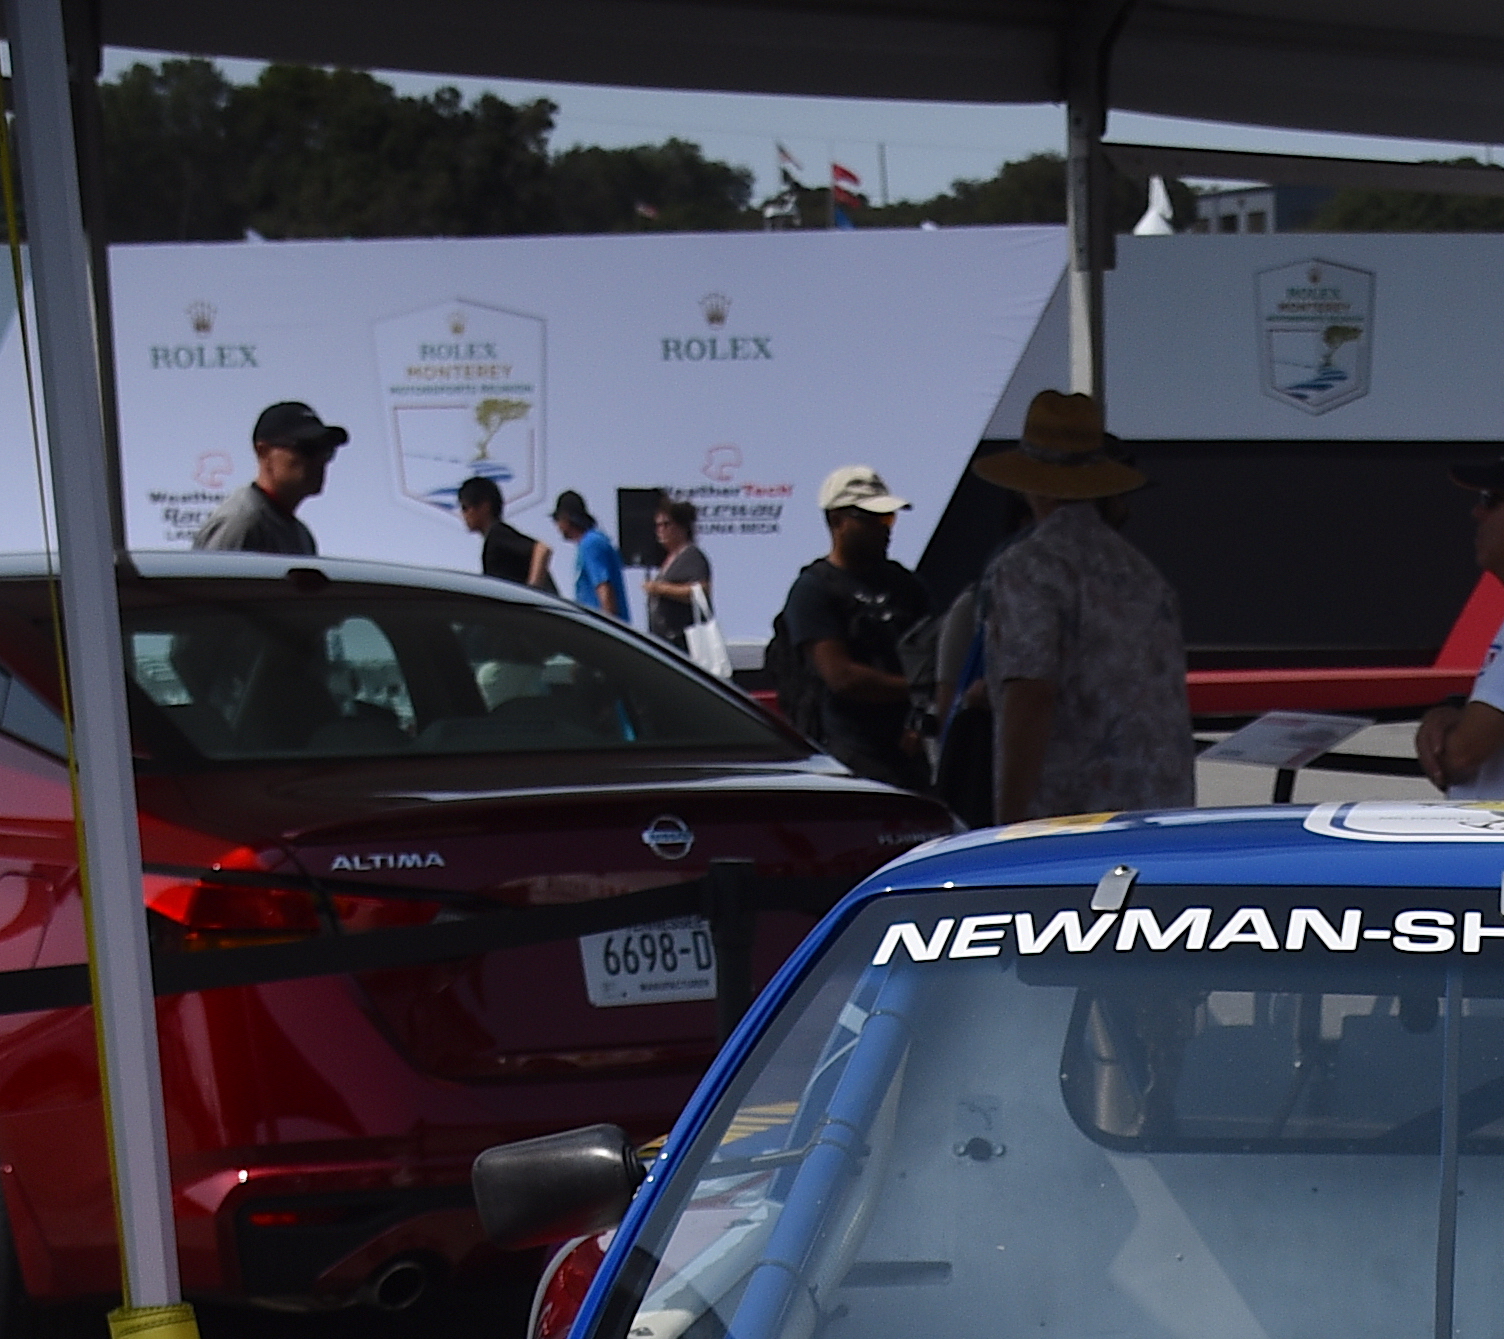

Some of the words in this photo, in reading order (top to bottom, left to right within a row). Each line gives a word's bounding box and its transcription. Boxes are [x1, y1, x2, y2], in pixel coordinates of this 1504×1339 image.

[149, 345, 259, 369] ROLEX
[660, 337, 773, 361] ROLEX
[331, 853, 445, 870] ALTIMA
[603, 929, 713, 977] 6698-D
